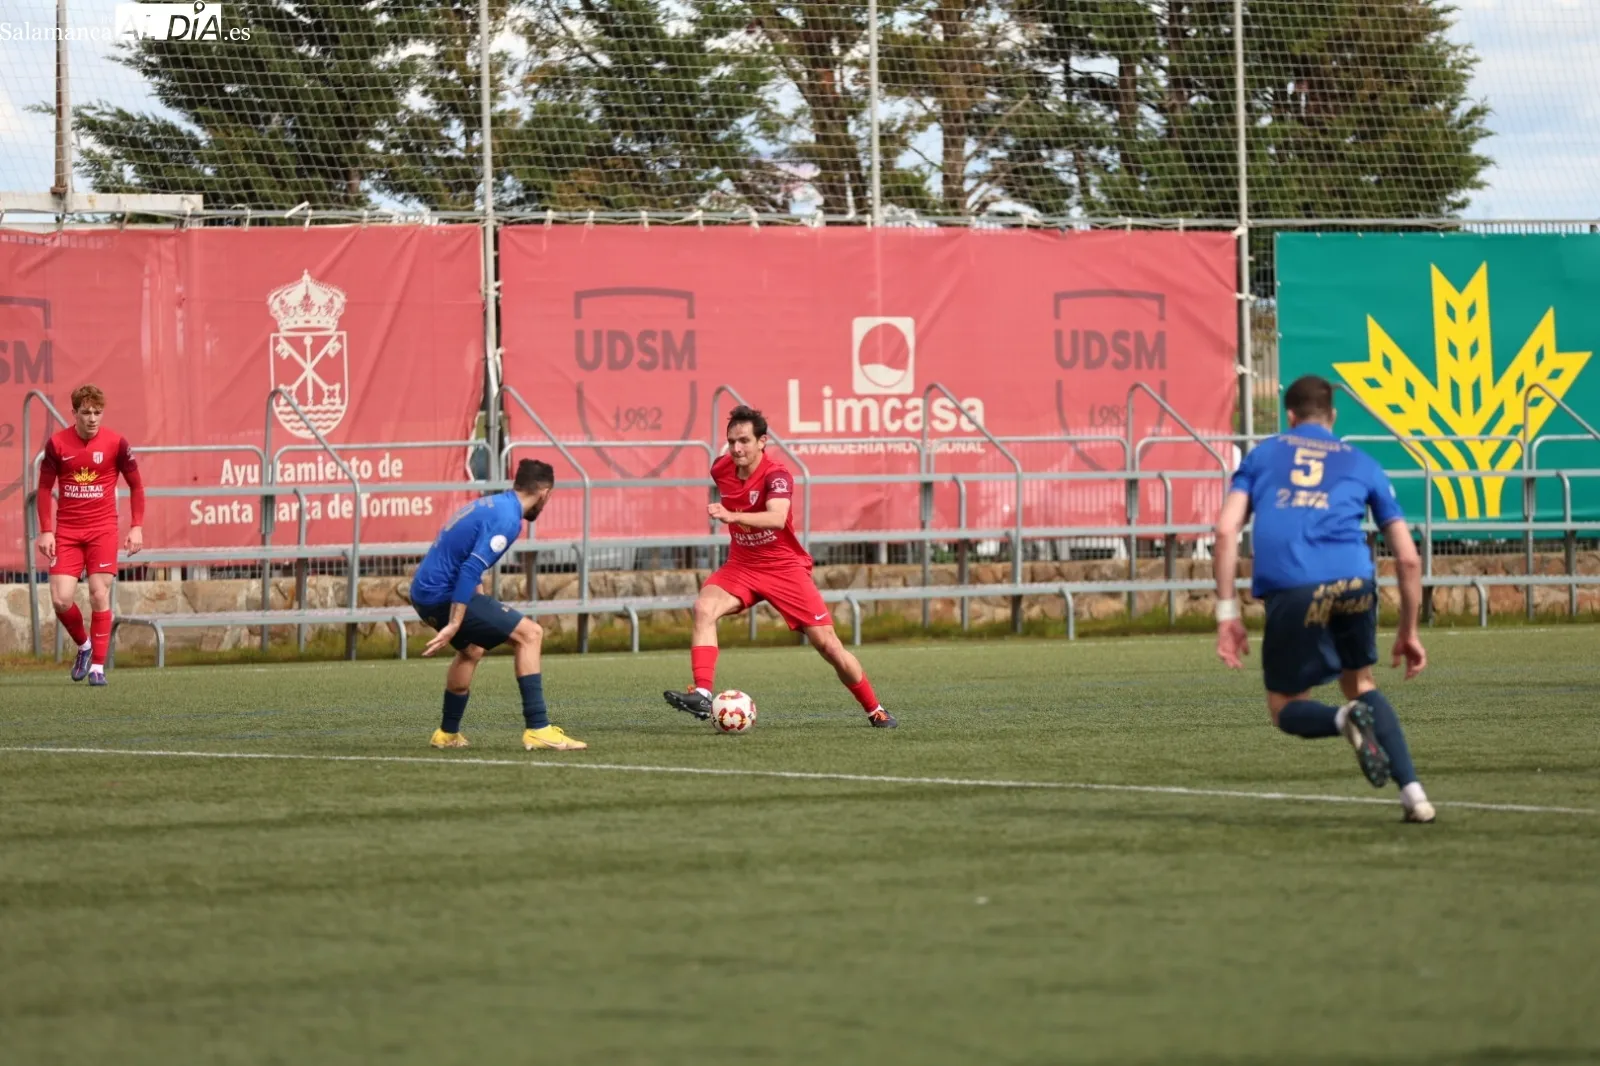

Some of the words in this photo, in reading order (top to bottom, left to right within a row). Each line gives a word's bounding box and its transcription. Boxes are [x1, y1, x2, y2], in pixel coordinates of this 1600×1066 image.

[574, 329, 697, 371] UDSM
[1053, 329, 1167, 371] UDSM
[613, 405, 663, 432] 1982
[788, 378, 985, 433] Limcasa
[220, 455, 372, 487] Ayutamiento
[378, 453, 403, 477] de
[1290, 447, 1328, 487] 5
[190, 500, 253, 525] Santa
[271, 496, 322, 522] ara
[327, 493, 353, 519] de
[360, 493, 433, 518] Tormes
